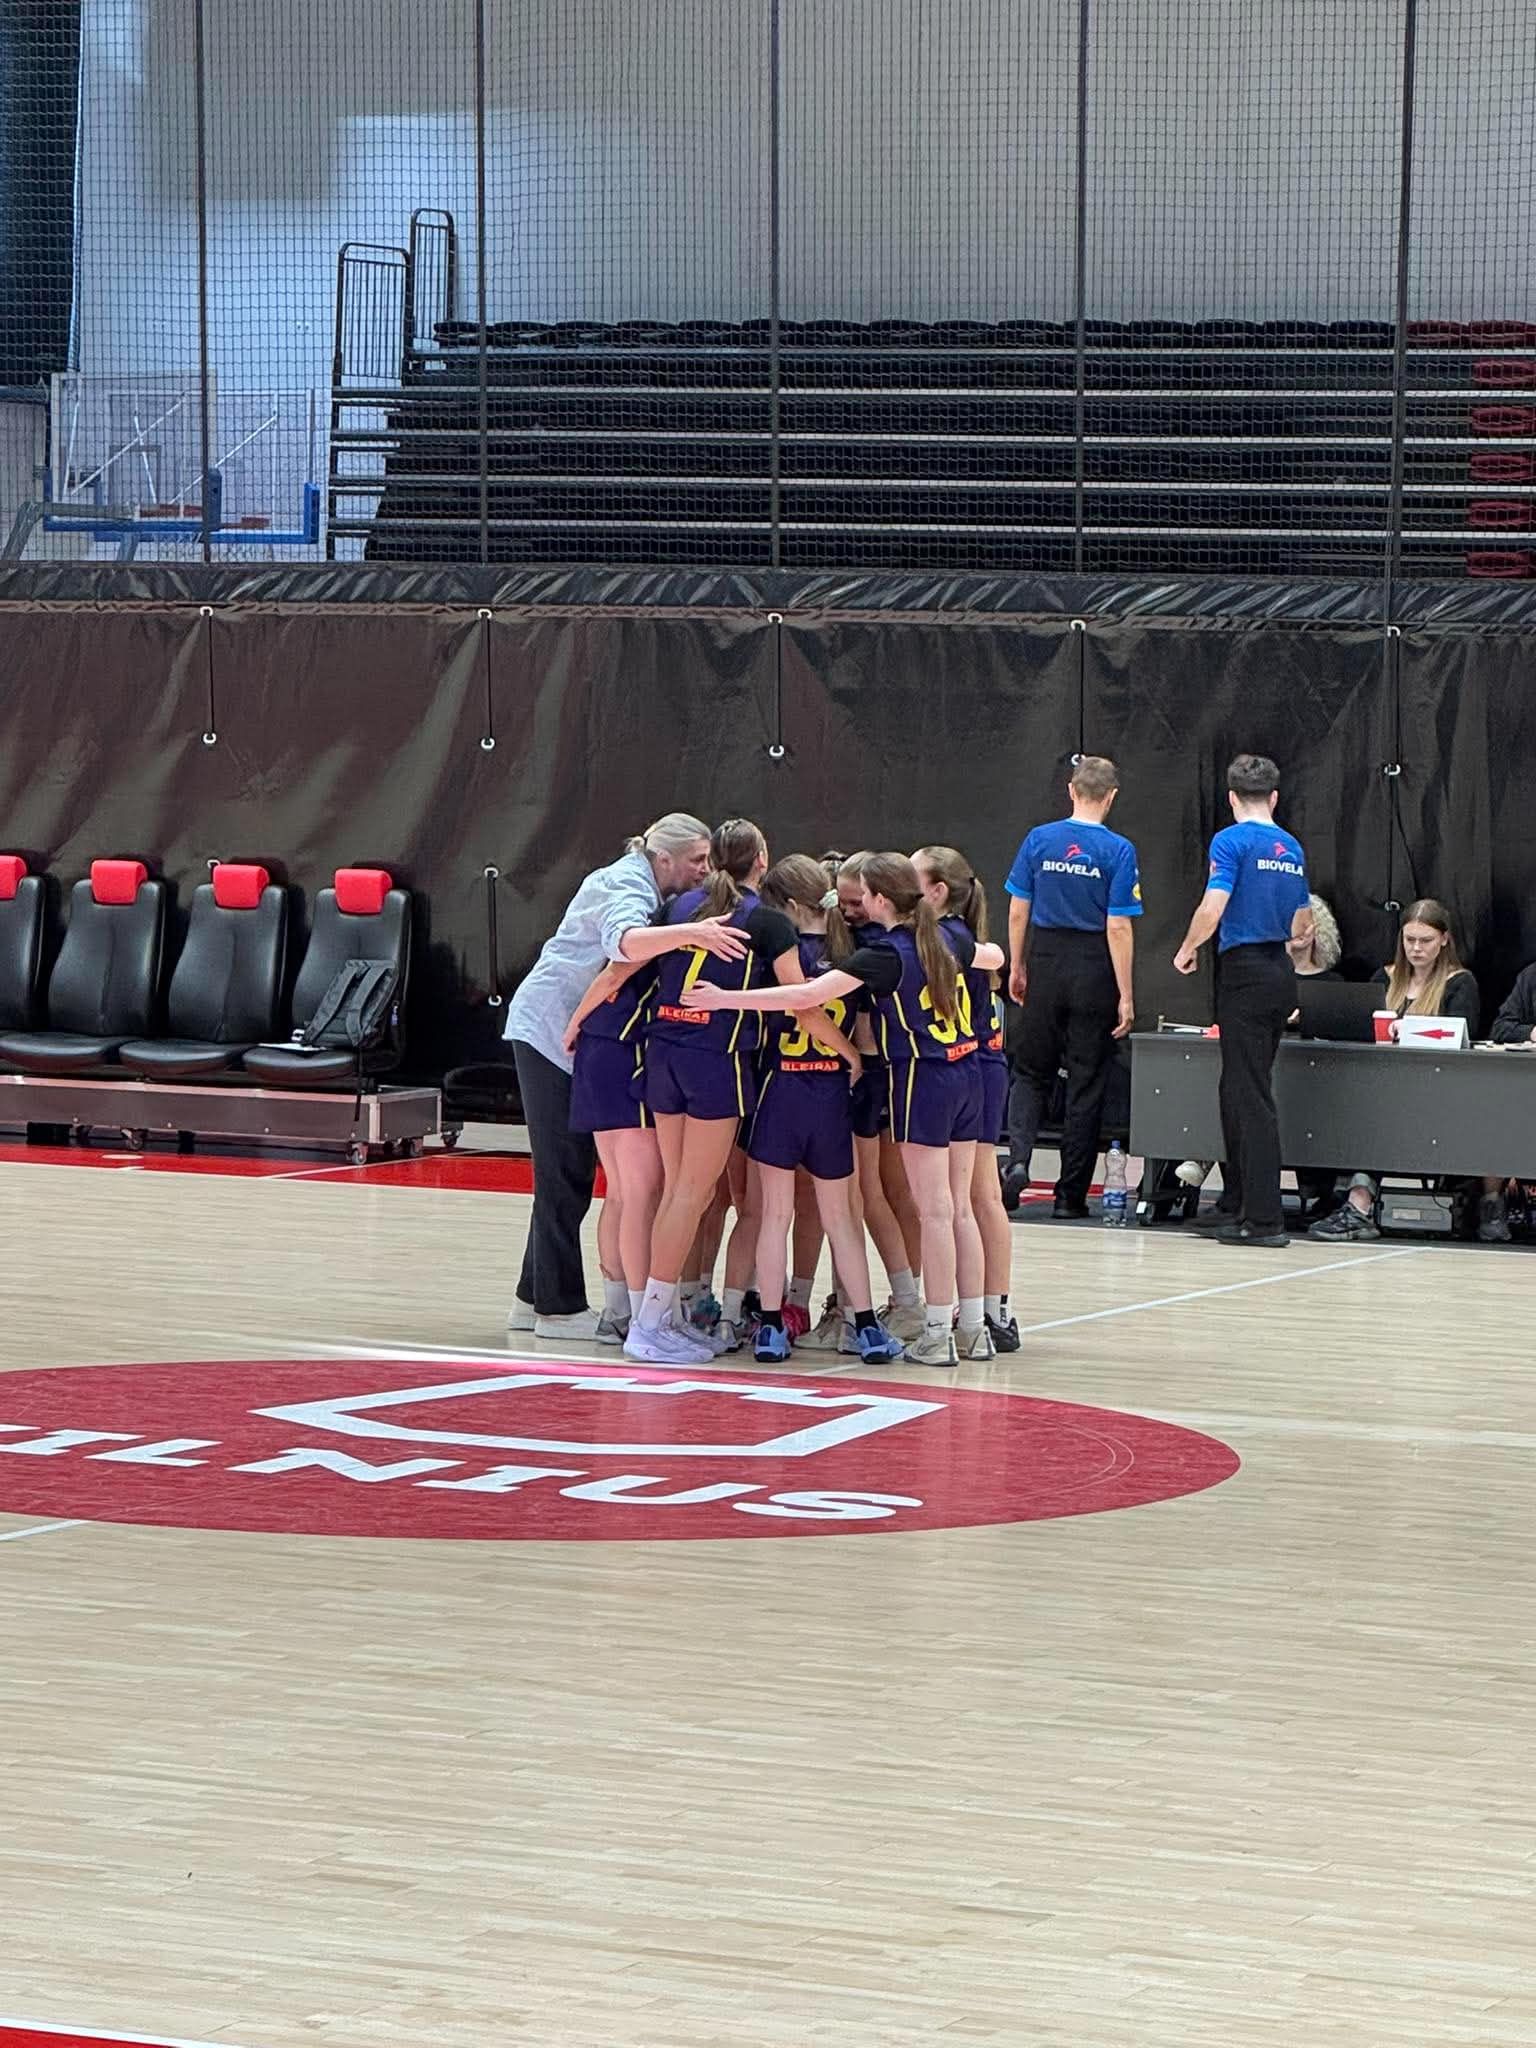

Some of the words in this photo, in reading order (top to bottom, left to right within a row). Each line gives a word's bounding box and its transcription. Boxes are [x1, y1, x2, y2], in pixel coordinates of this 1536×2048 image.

[1042, 860, 1101, 878] BIOVELA
[1257, 859, 1304, 876] BIOVELA
[0, 1424, 924, 1520] ILNIUS
